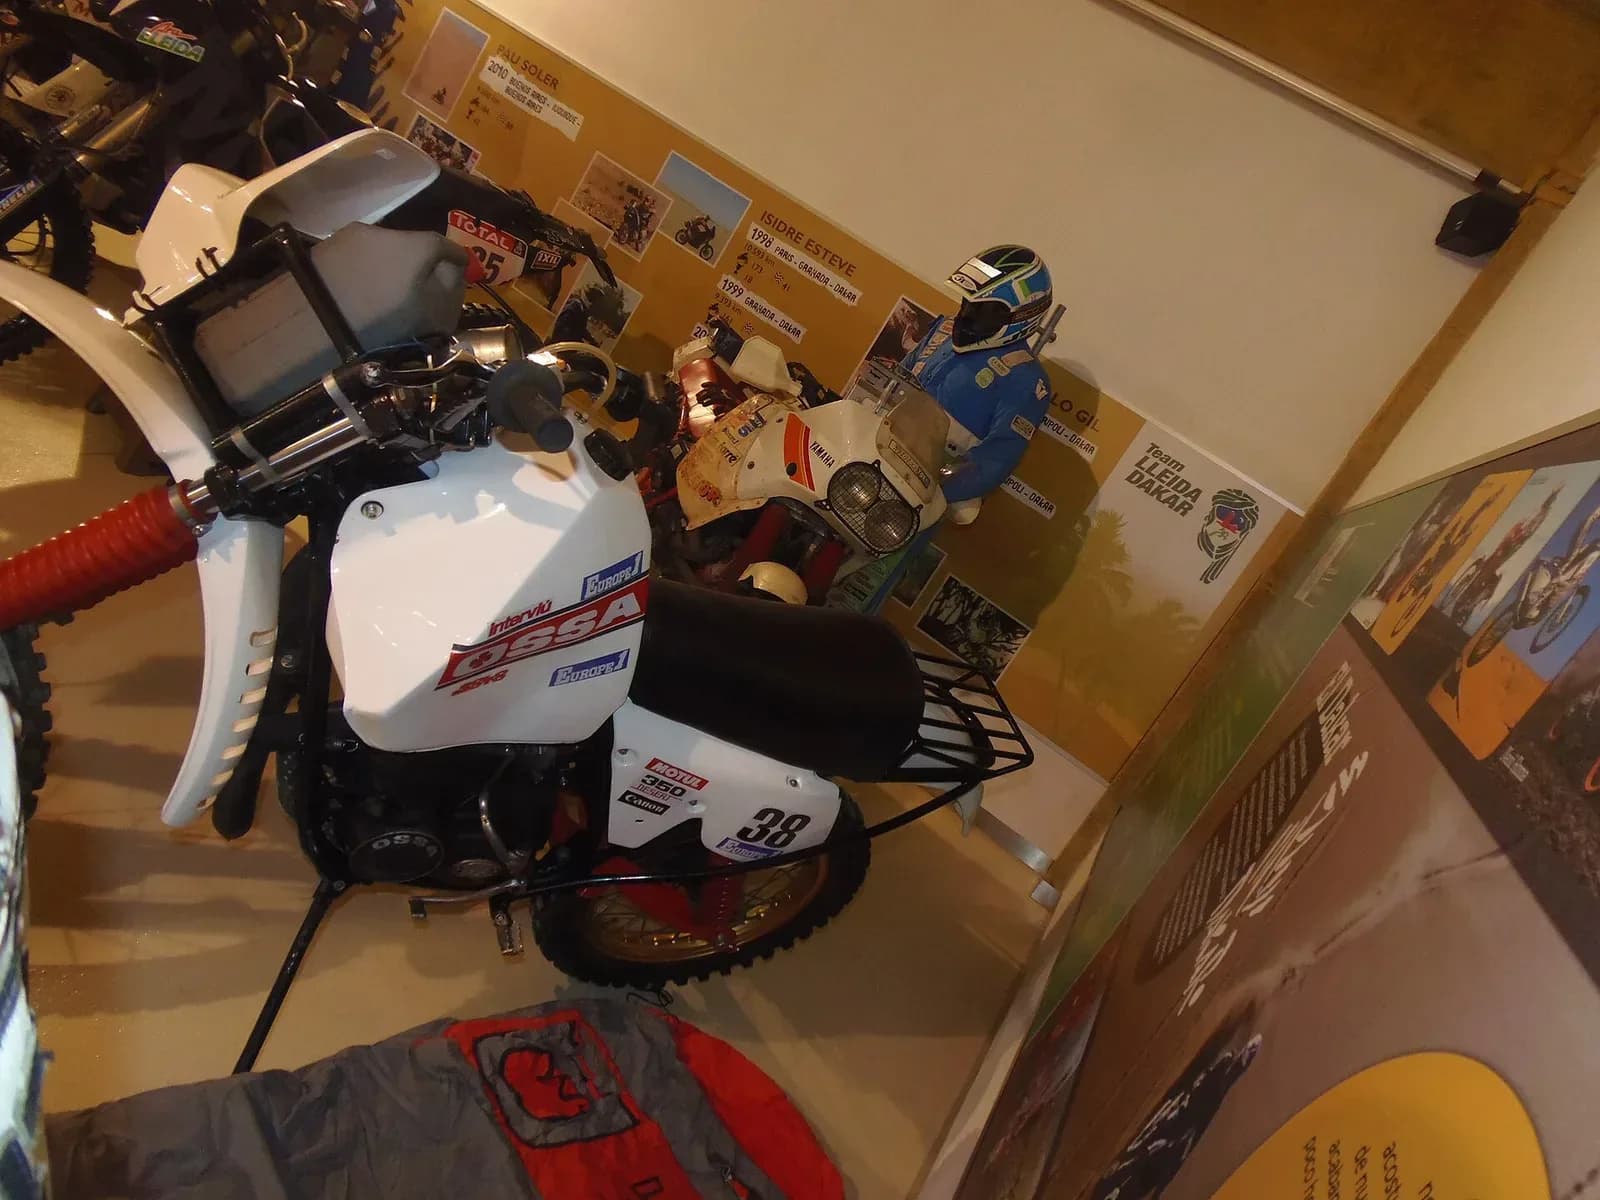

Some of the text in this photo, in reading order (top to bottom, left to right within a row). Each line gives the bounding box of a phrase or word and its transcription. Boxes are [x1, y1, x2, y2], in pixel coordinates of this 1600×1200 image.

[488, 60, 508, 80] 2010
[496, 44, 560, 90] PAU SOLER
[454, 213, 509, 249] TOTAL
[760, 210, 857, 278] ISIDRE ESTEVE
[470, 246, 505, 284] 5
[751, 228, 775, 249] 1998
[774, 246, 796, 266] PARIS
[798, 261, 831, 287] GRANADA
[833, 283, 857, 303] DAKAR
[722, 278, 744, 299] 1999
[744, 297, 776, 322] GRANADA
[778, 318, 802, 339] DAKAR
[1076, 408, 1100, 432] GIL
[809, 441, 836, 468] YAMAHA
[1069, 435, 1096, 456] DAKAR
[1147, 443, 1185, 473] Team
[1125, 470, 1194, 518] DAKAR
[1134, 456, 1202, 504] LLEIDA
[1029, 492, 1055, 514] DAKAR
[452, 592, 642, 679] OSSA
[641, 774, 687, 798] 350
[650, 761, 702, 789] MOTUL
[624, 794, 664, 814] Canon
[736, 807, 811, 849] 38
